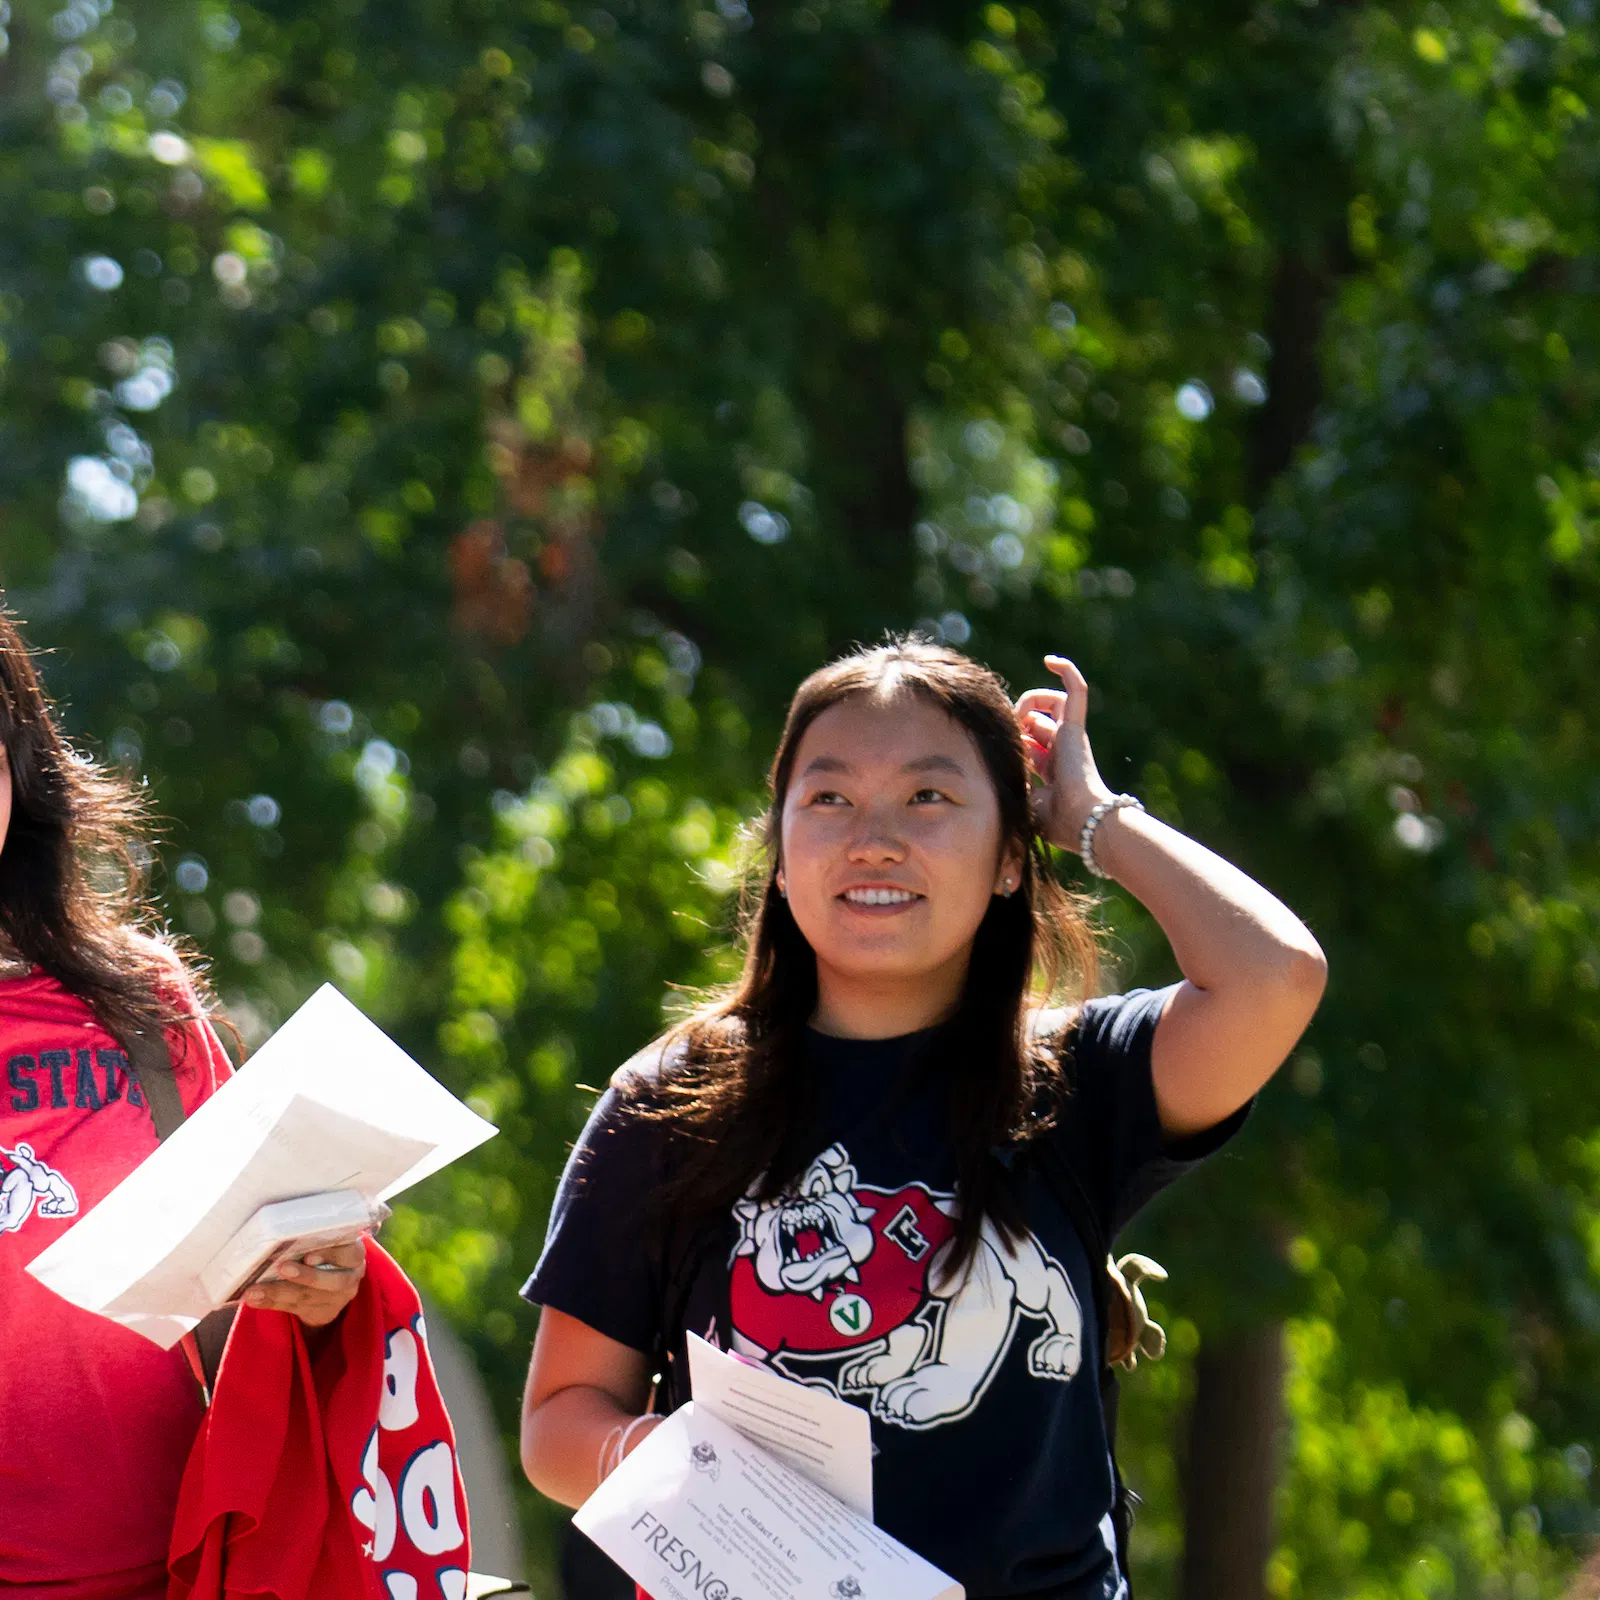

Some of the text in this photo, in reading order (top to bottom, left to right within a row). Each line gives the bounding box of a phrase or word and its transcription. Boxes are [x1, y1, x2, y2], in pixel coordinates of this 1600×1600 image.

[883, 1205, 930, 1261] F
[834, 1299, 860, 1331] V
[738, 1504, 774, 1539] Contact
